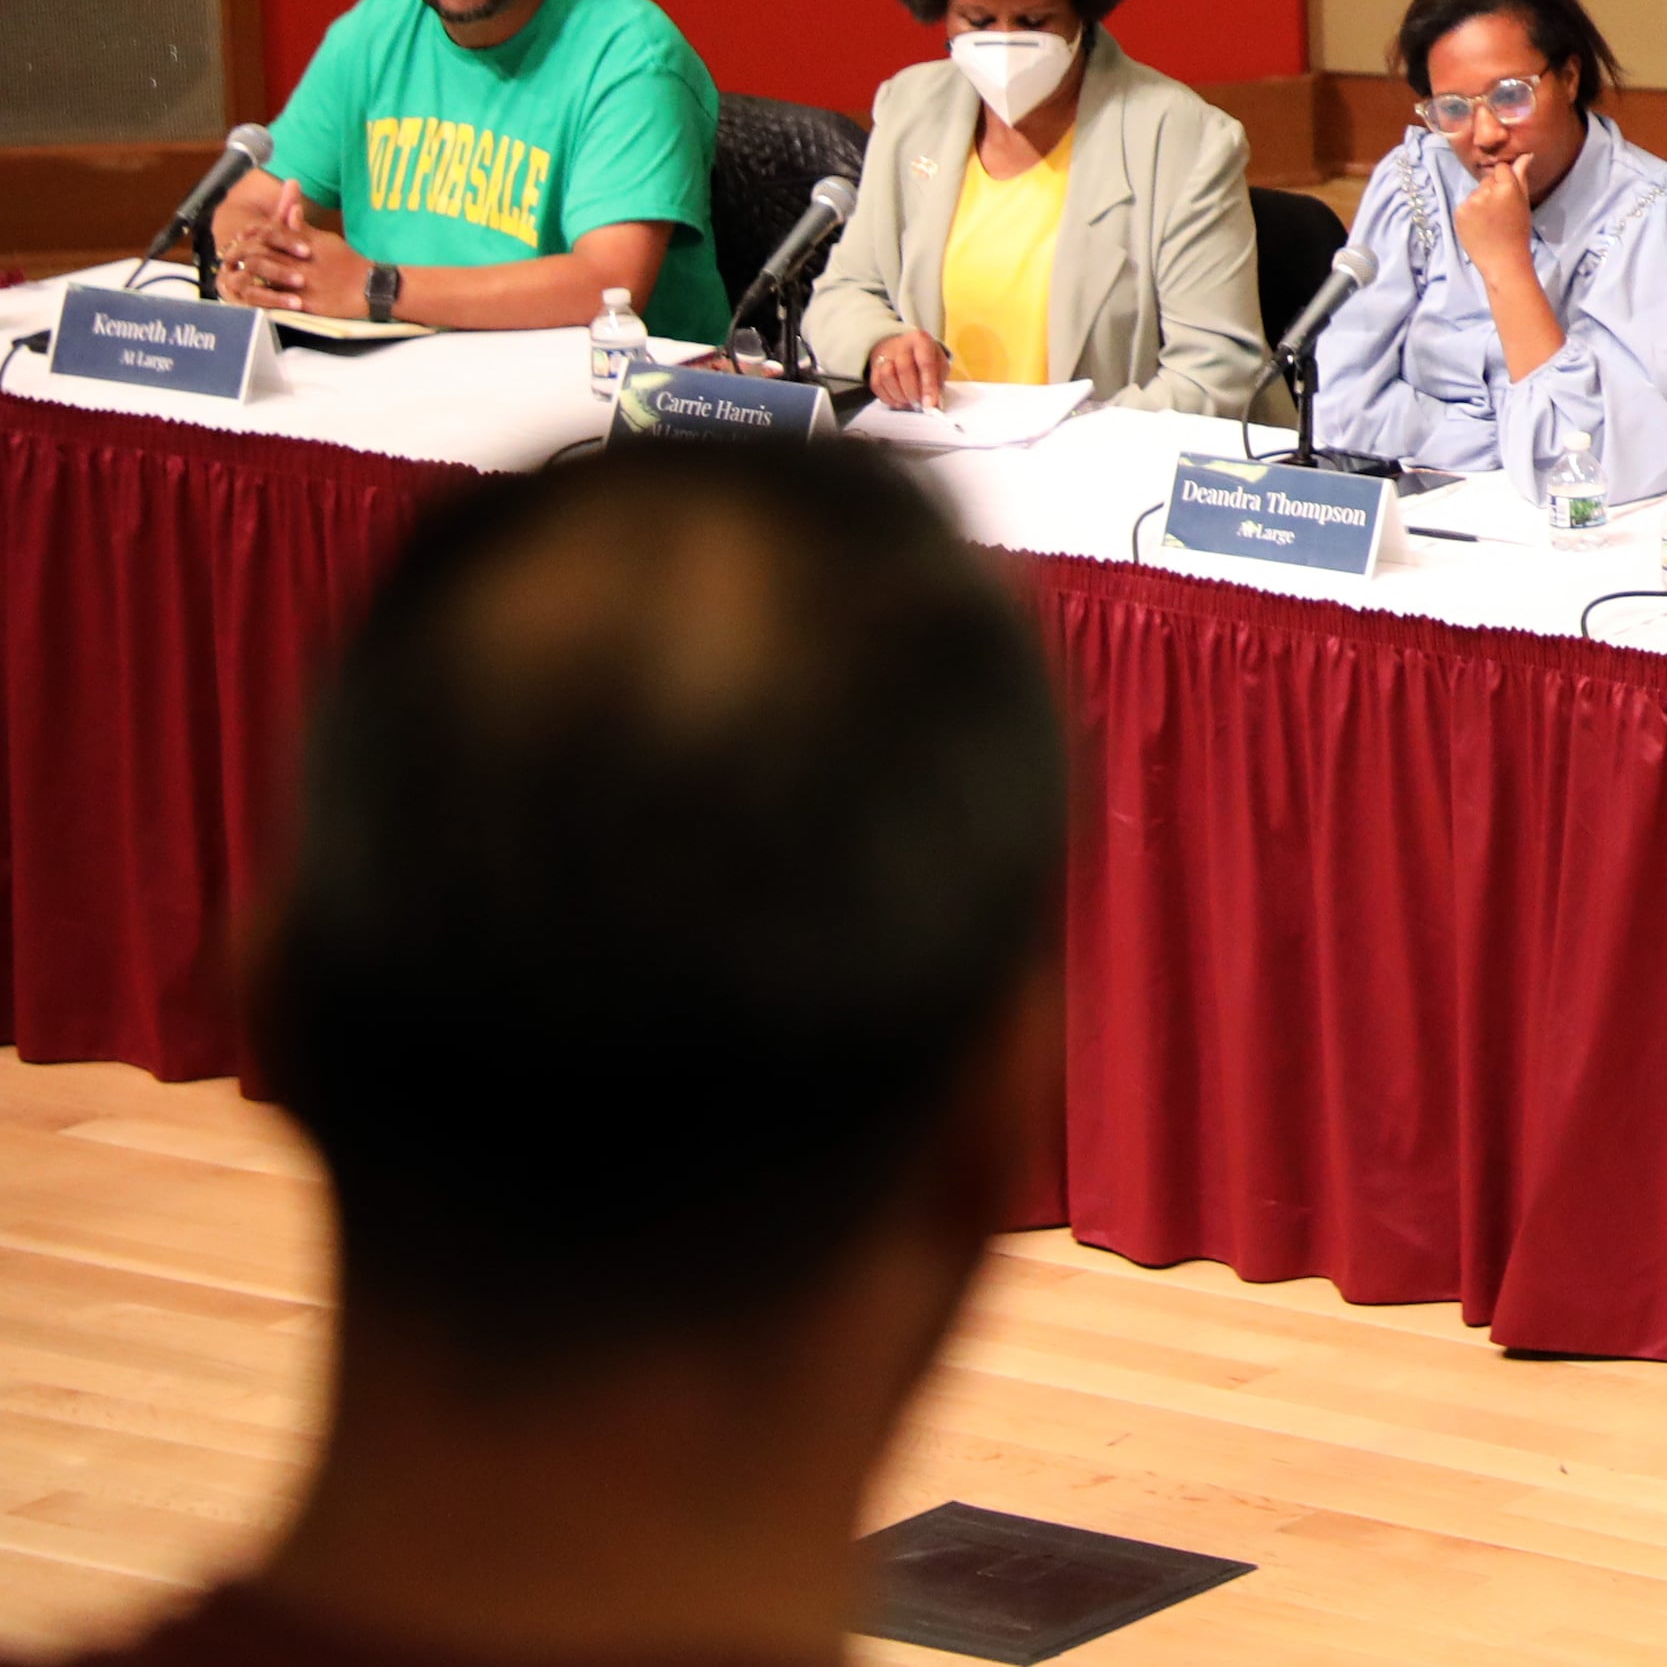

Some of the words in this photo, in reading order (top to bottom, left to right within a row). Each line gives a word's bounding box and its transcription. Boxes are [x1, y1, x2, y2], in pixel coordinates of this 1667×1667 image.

[366, 117, 423, 211] OT
[464, 130, 550, 248] SALE
[92, 312, 167, 344] Kenneth
[169, 323, 216, 351] Allen
[121, 350, 135, 366] At
[137, 351, 174, 372] Large
[656, 391, 712, 418] Carrie
[715, 399, 774, 427] Harris
[1182, 480, 1262, 512] Deandra
[1266, 491, 1367, 527] Thompson
[1256, 523, 1296, 546] Large
